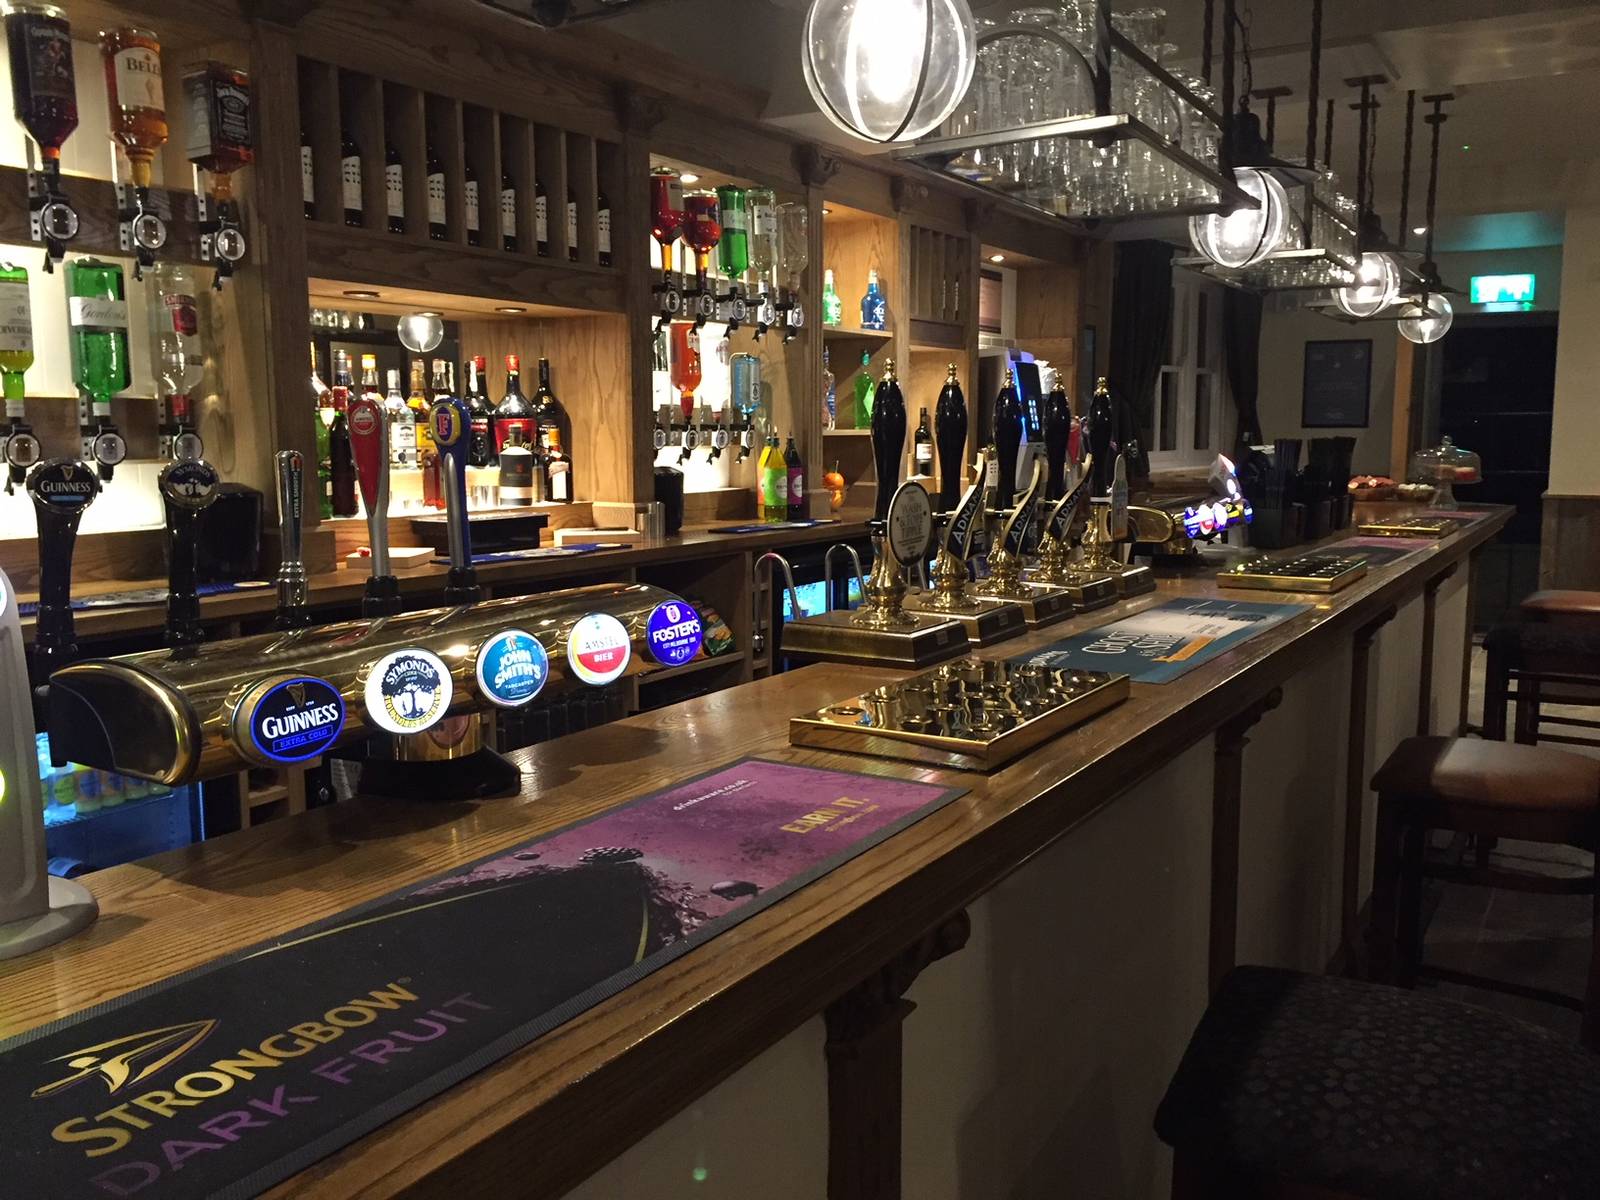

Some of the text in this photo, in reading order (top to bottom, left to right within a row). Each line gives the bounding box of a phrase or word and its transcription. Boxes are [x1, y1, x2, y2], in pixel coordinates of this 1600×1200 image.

[40, 480, 91, 493] GUINNESS
[585, 636, 620, 650] AMSTEL
[653, 619, 701, 643] FOSTER'S
[500, 649, 532, 670] JOHN
[593, 652, 614, 662] BIER
[386, 660, 436, 685] SYMONDS
[495, 662, 541, 689] SMITH'S
[262, 703, 339, 739] GUINNESS
[280, 728, 328, 749] EXTRA COLD
[779, 796, 871, 834] EARN IT.
[51, 982, 421, 1158] STRONGBOW
[89, 992, 496, 1197] DARK FRUIT
